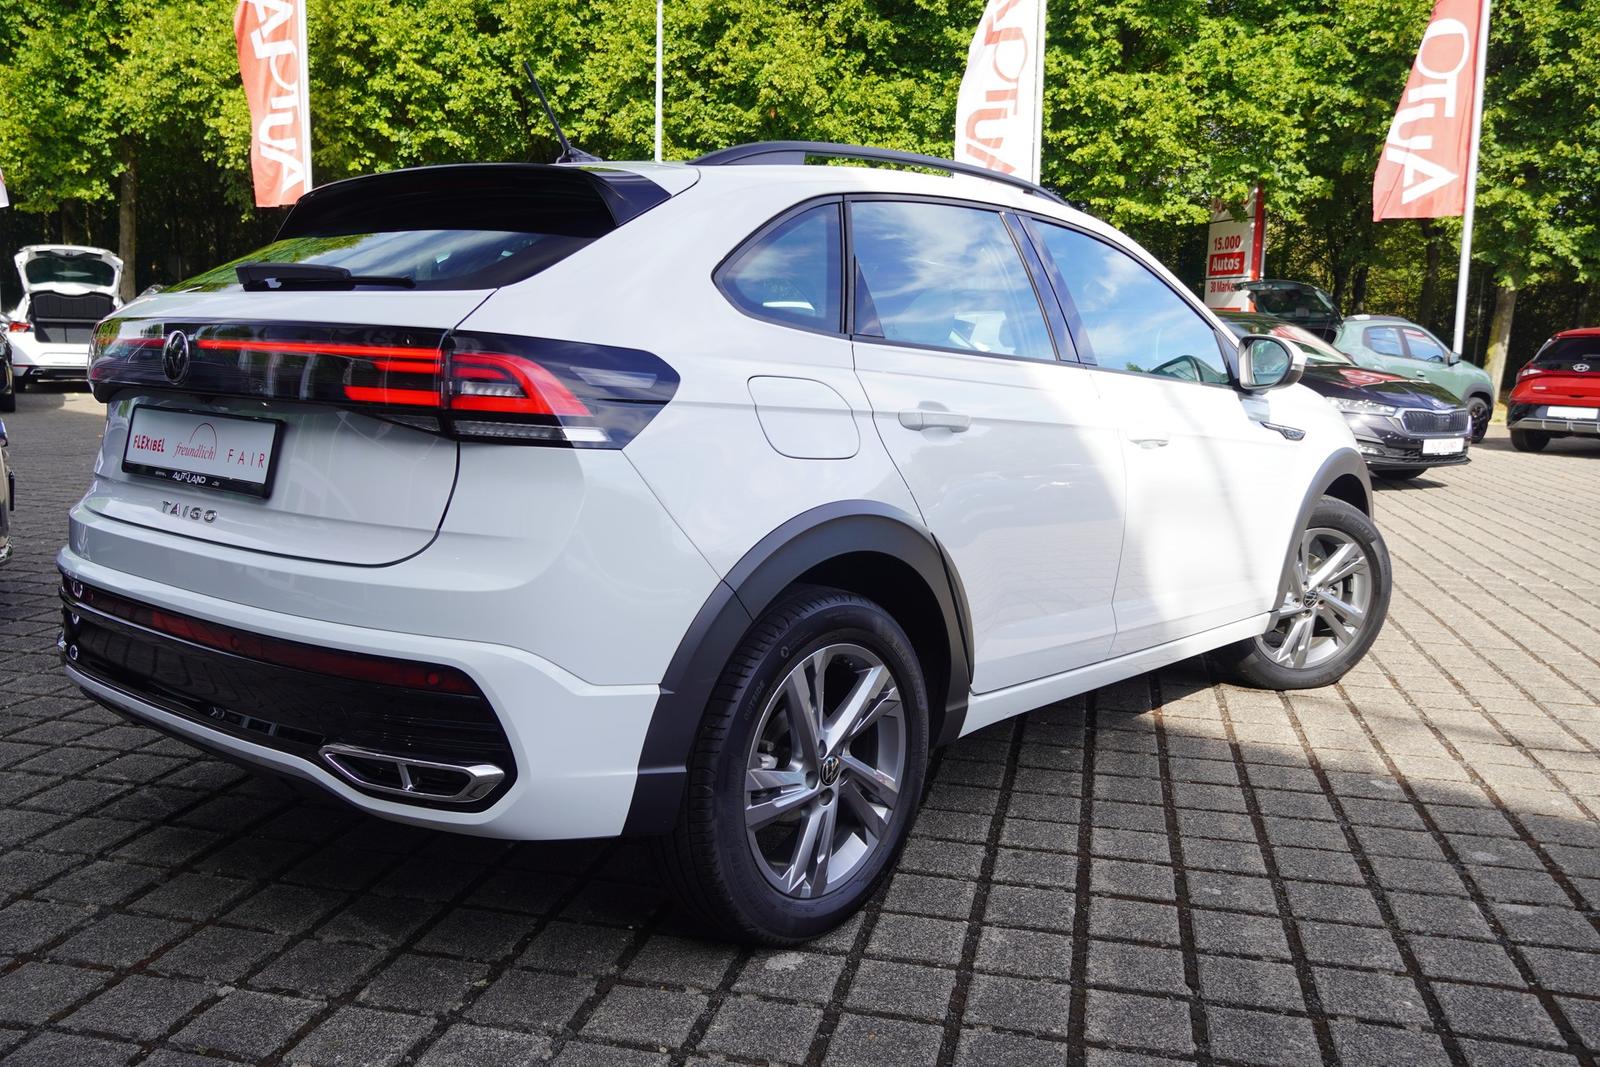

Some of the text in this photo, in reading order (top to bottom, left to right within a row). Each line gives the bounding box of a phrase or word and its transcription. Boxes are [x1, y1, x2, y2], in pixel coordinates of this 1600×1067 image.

[1214, 235, 1241, 251] 15.000
[1211, 256, 1240, 272] Autos
[133, 434, 165, 453] FLEXIBEL
[173, 442, 214, 461] freundlich
[227, 448, 265, 469] FAIR
[161, 500, 218, 523] TAIGO
